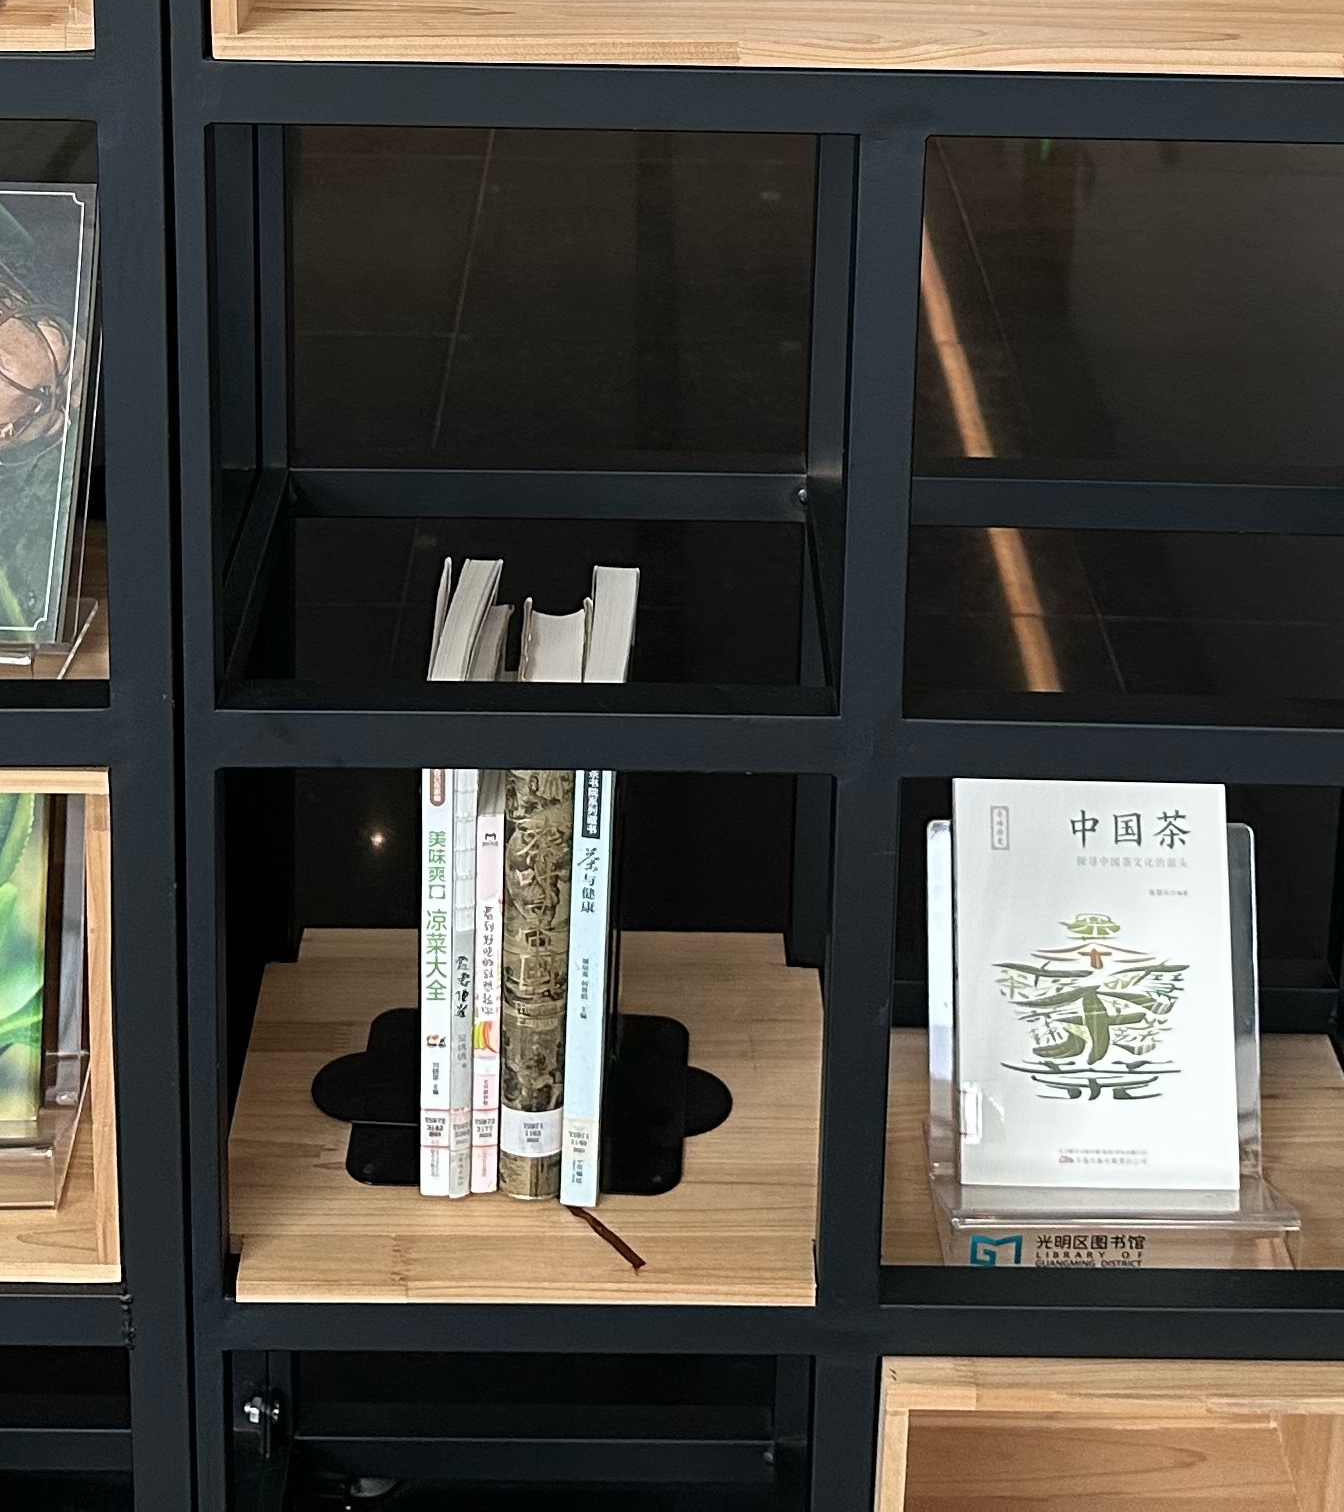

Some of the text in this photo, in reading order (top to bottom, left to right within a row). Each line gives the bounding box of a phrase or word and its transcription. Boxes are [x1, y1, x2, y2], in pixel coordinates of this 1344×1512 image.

[1070, 808, 1192, 850] 中国茶
[577, 846, 600, 914] 茶与健康
[426, 830, 448, 1001] 美味爽口 凉菜大全
[1036, 1251, 1143, 1259] LIBRARY OF
[1037, 1234, 1146, 1250] 光明区图书馆
[1035, 1259, 1143, 1268] GUANGMING DISTRICT
